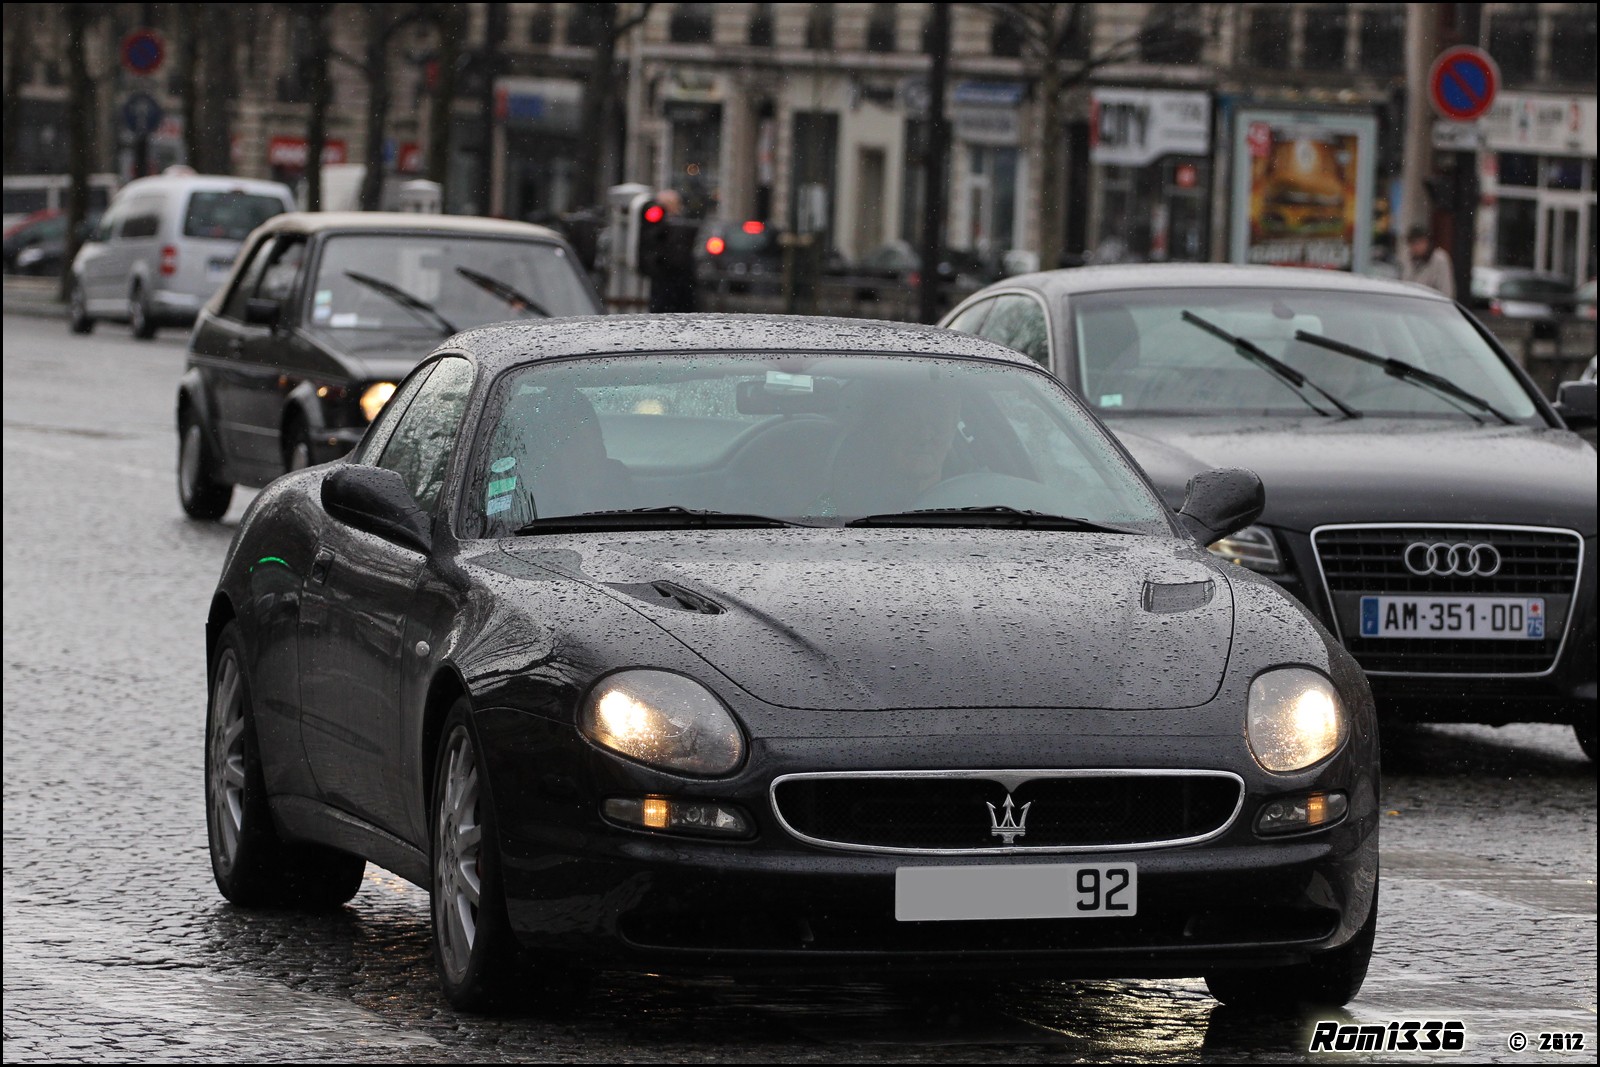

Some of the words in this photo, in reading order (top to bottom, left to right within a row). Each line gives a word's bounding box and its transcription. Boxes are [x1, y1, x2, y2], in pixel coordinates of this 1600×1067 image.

[1100, 103, 1151, 147] CITY
[1384, 602, 1523, 632] AM-351-DD
[1527, 619, 1543, 635] 75
[1076, 868, 1130, 911] 92
